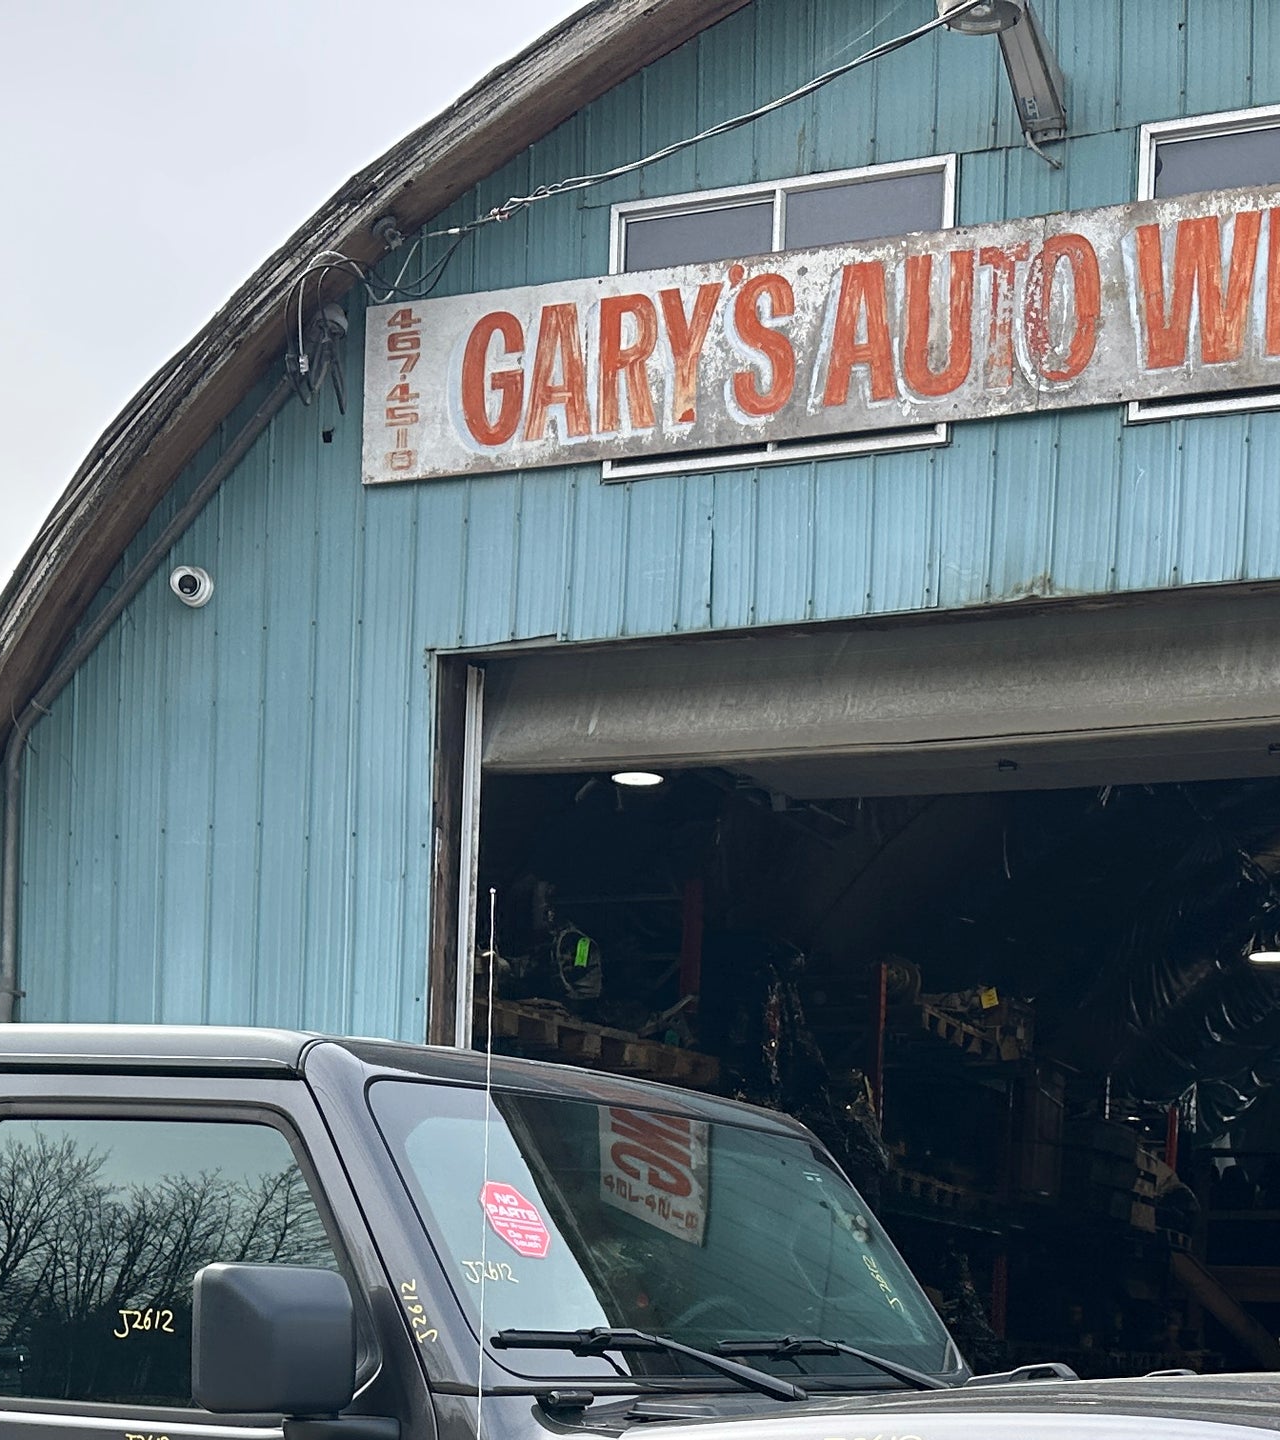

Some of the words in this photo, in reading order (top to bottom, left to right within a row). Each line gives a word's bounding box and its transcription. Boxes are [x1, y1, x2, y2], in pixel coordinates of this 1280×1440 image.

[461, 263, 795, 446] GARY'S
[823, 234, 1100, 407] AUTO
[494, 1192, 518, 1206] NO
[114, 1308, 174, 1338] J2612
[401, 1278, 438, 1343] J2612
